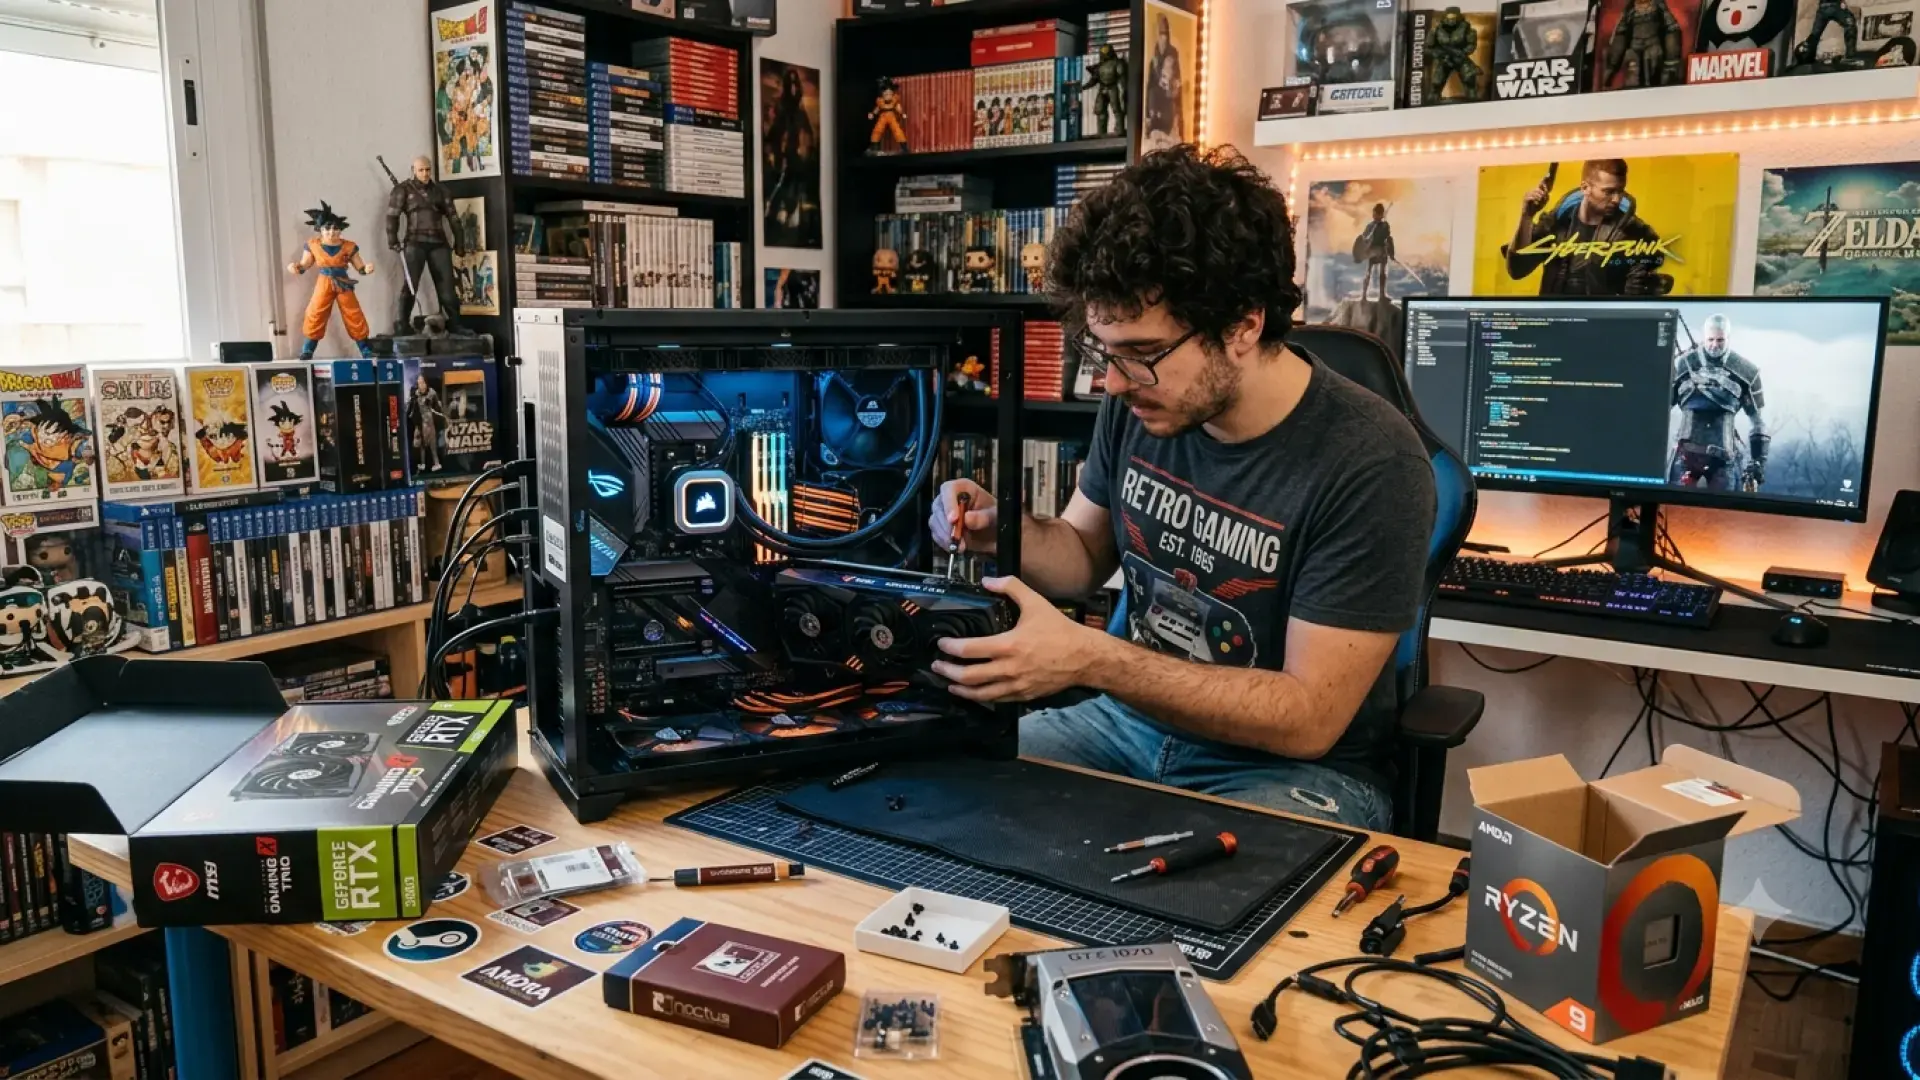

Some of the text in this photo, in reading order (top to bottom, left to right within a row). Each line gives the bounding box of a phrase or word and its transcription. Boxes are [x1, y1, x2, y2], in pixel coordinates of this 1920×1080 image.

[1497, 58, 1575, 81] STAR
[1690, 51, 1765, 82] MARVEL
[1497, 75, 1575, 98] WARS
[1802, 210, 1920, 257] ZELDA
[1121, 467, 1281, 573] RETRO GAMING
[1159, 531, 1185, 558] EST.
[421, 715, 474, 744] RTX
[347, 840, 380, 909] RTX
[1484, 884, 1578, 953] RYZEN
[1112, 947, 1154, 959] 1070
[1568, 1004, 1587, 1034] 9
